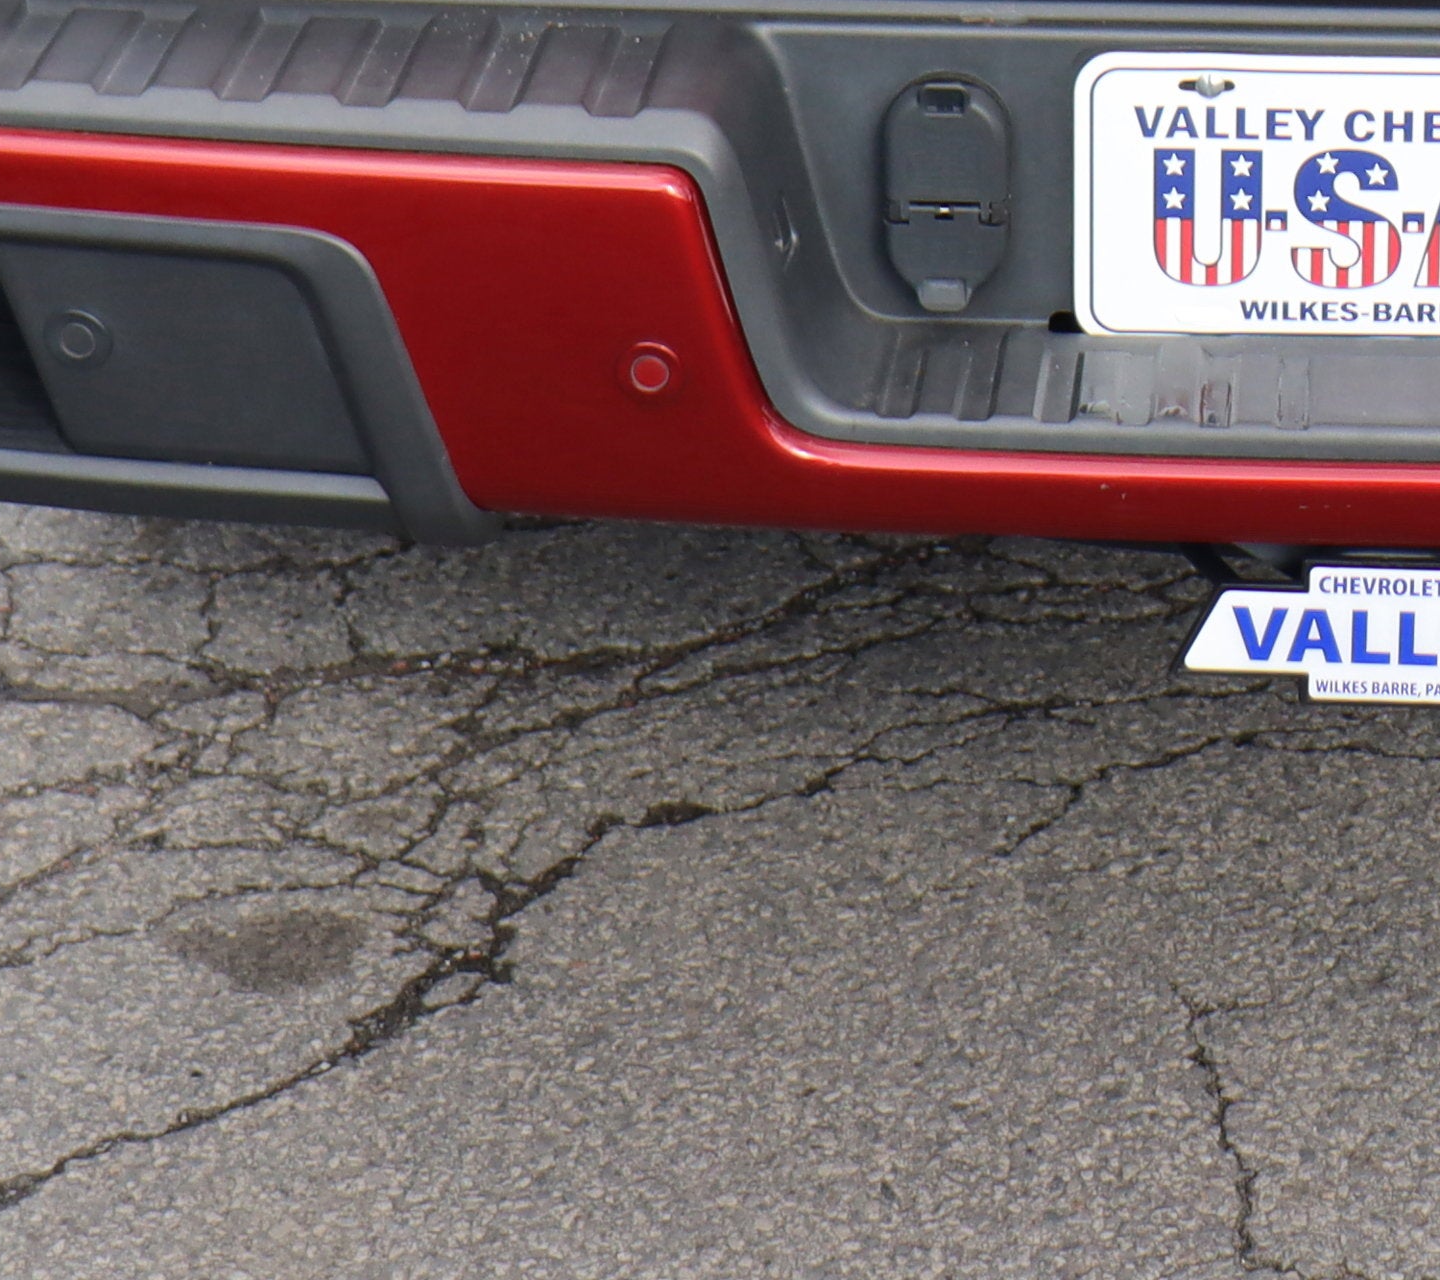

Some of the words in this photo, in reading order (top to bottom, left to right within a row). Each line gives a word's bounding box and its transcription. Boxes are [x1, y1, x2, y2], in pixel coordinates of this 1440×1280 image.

[1133, 105, 1326, 141] VALLEY
[1315, 678, 1368, 695] WILKES
[1371, 680, 1422, 699] BARRE,
